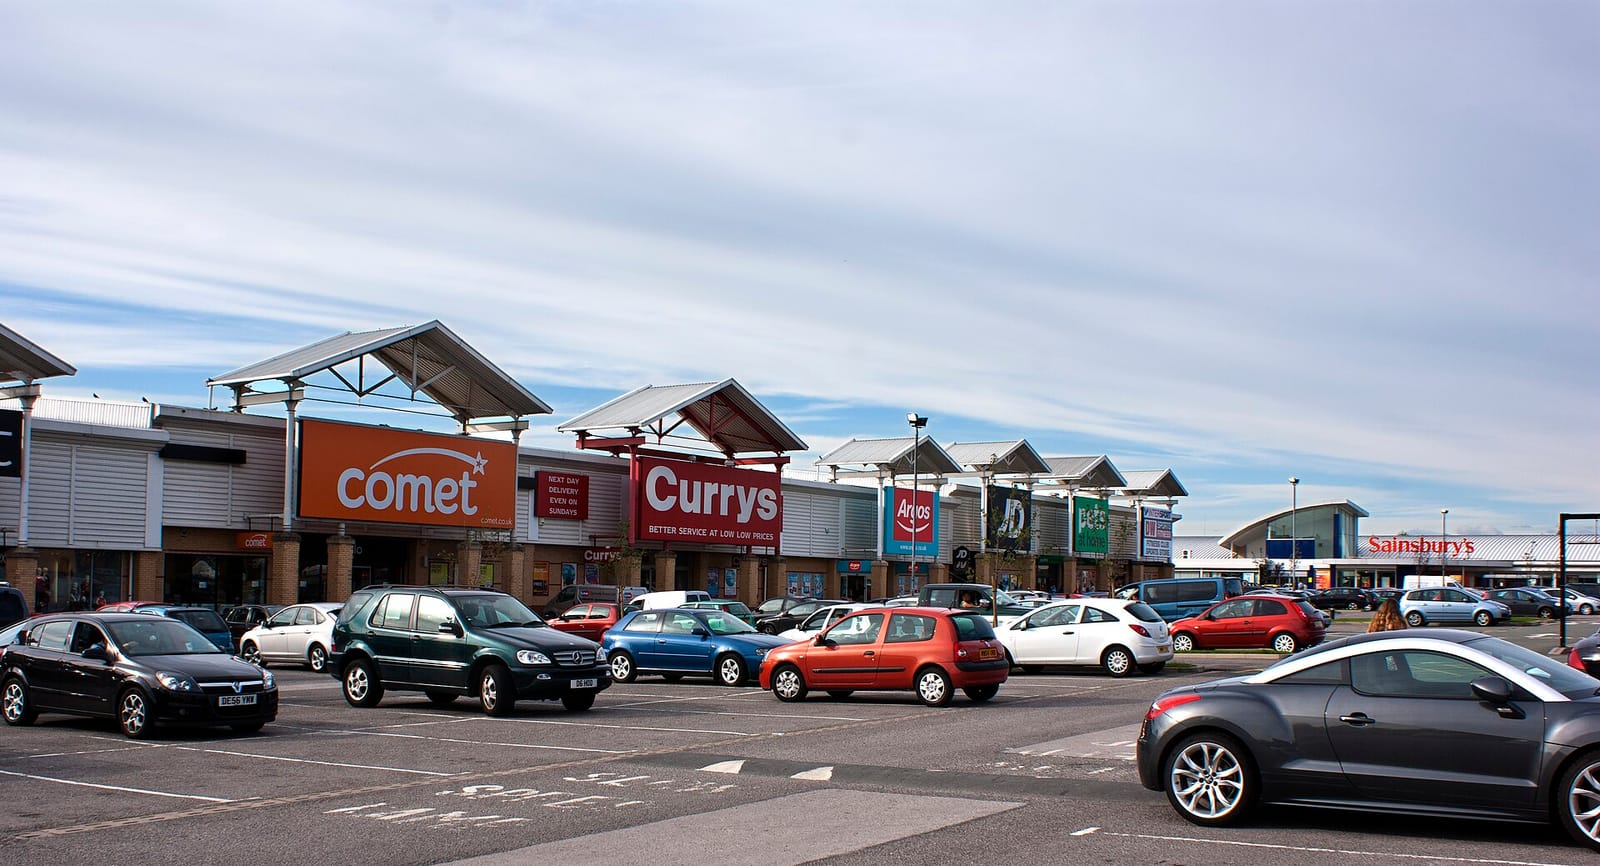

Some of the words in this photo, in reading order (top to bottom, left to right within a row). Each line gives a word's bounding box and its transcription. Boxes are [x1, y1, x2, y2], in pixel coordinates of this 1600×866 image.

[548, 475, 565, 484] NEXT
[566, 477, 579, 485] DAY
[337, 467, 478, 516] comet
[548, 486, 579, 495] DELIVERY
[645, 465, 778, 524] Currys
[549, 496, 567, 505] EVEN
[568, 498, 578, 506] ON
[548, 507, 578, 516] SUNDAYS
[480, 518, 513, 526] comet.co.uk
[648, 525, 677, 535] BETTER
[678, 527, 707, 537] SERVICE
[709, 529, 719, 537] AT
[720, 530, 735, 539] LOW
[736, 531, 751, 539] LOW
[752, 532, 774, 541] PRICES
[245, 538, 267, 547] comet
[1368, 535, 1475, 557] Sainsbury's
